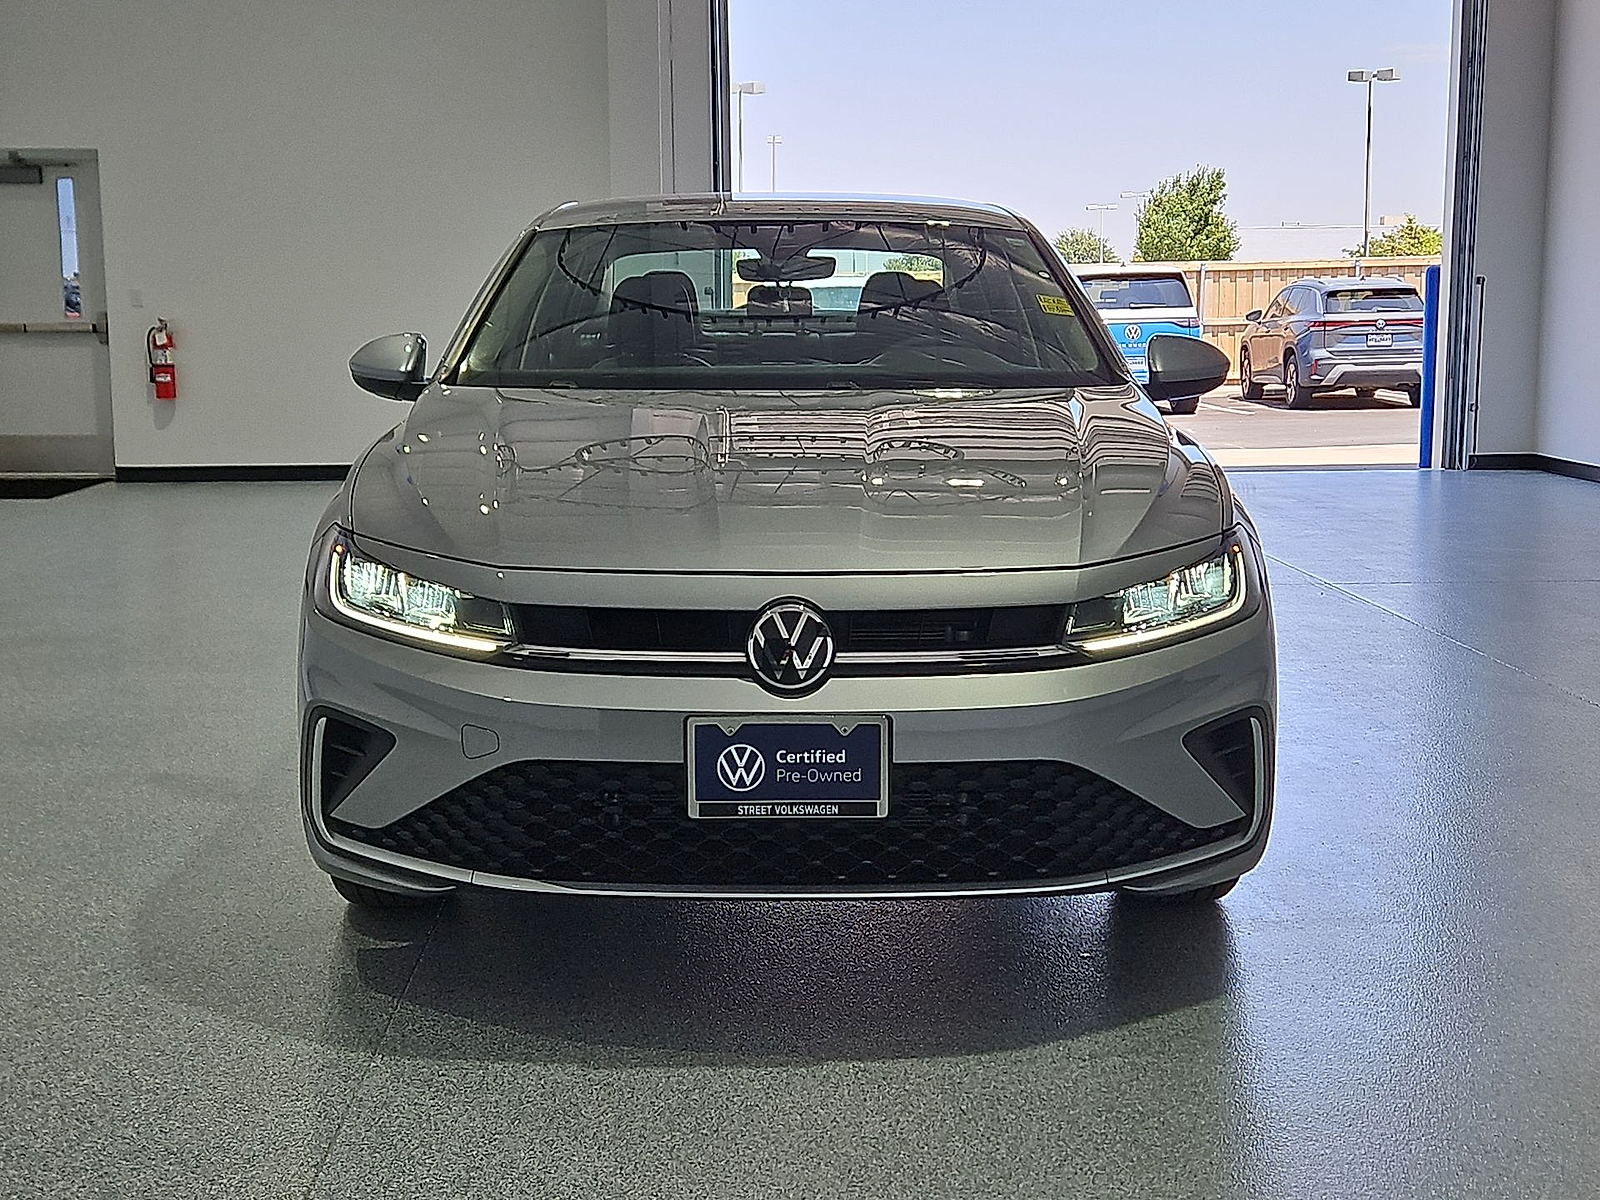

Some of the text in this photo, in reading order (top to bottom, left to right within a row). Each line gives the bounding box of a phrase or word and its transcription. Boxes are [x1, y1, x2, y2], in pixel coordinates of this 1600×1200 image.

[750, 606, 831, 687] VW
[776, 750, 845, 763] Certified
[718, 745, 764, 790] VW
[776, 768, 862, 782] Pre-Owned
[738, 805, 839, 815] STREET VOLKSWAGEN
